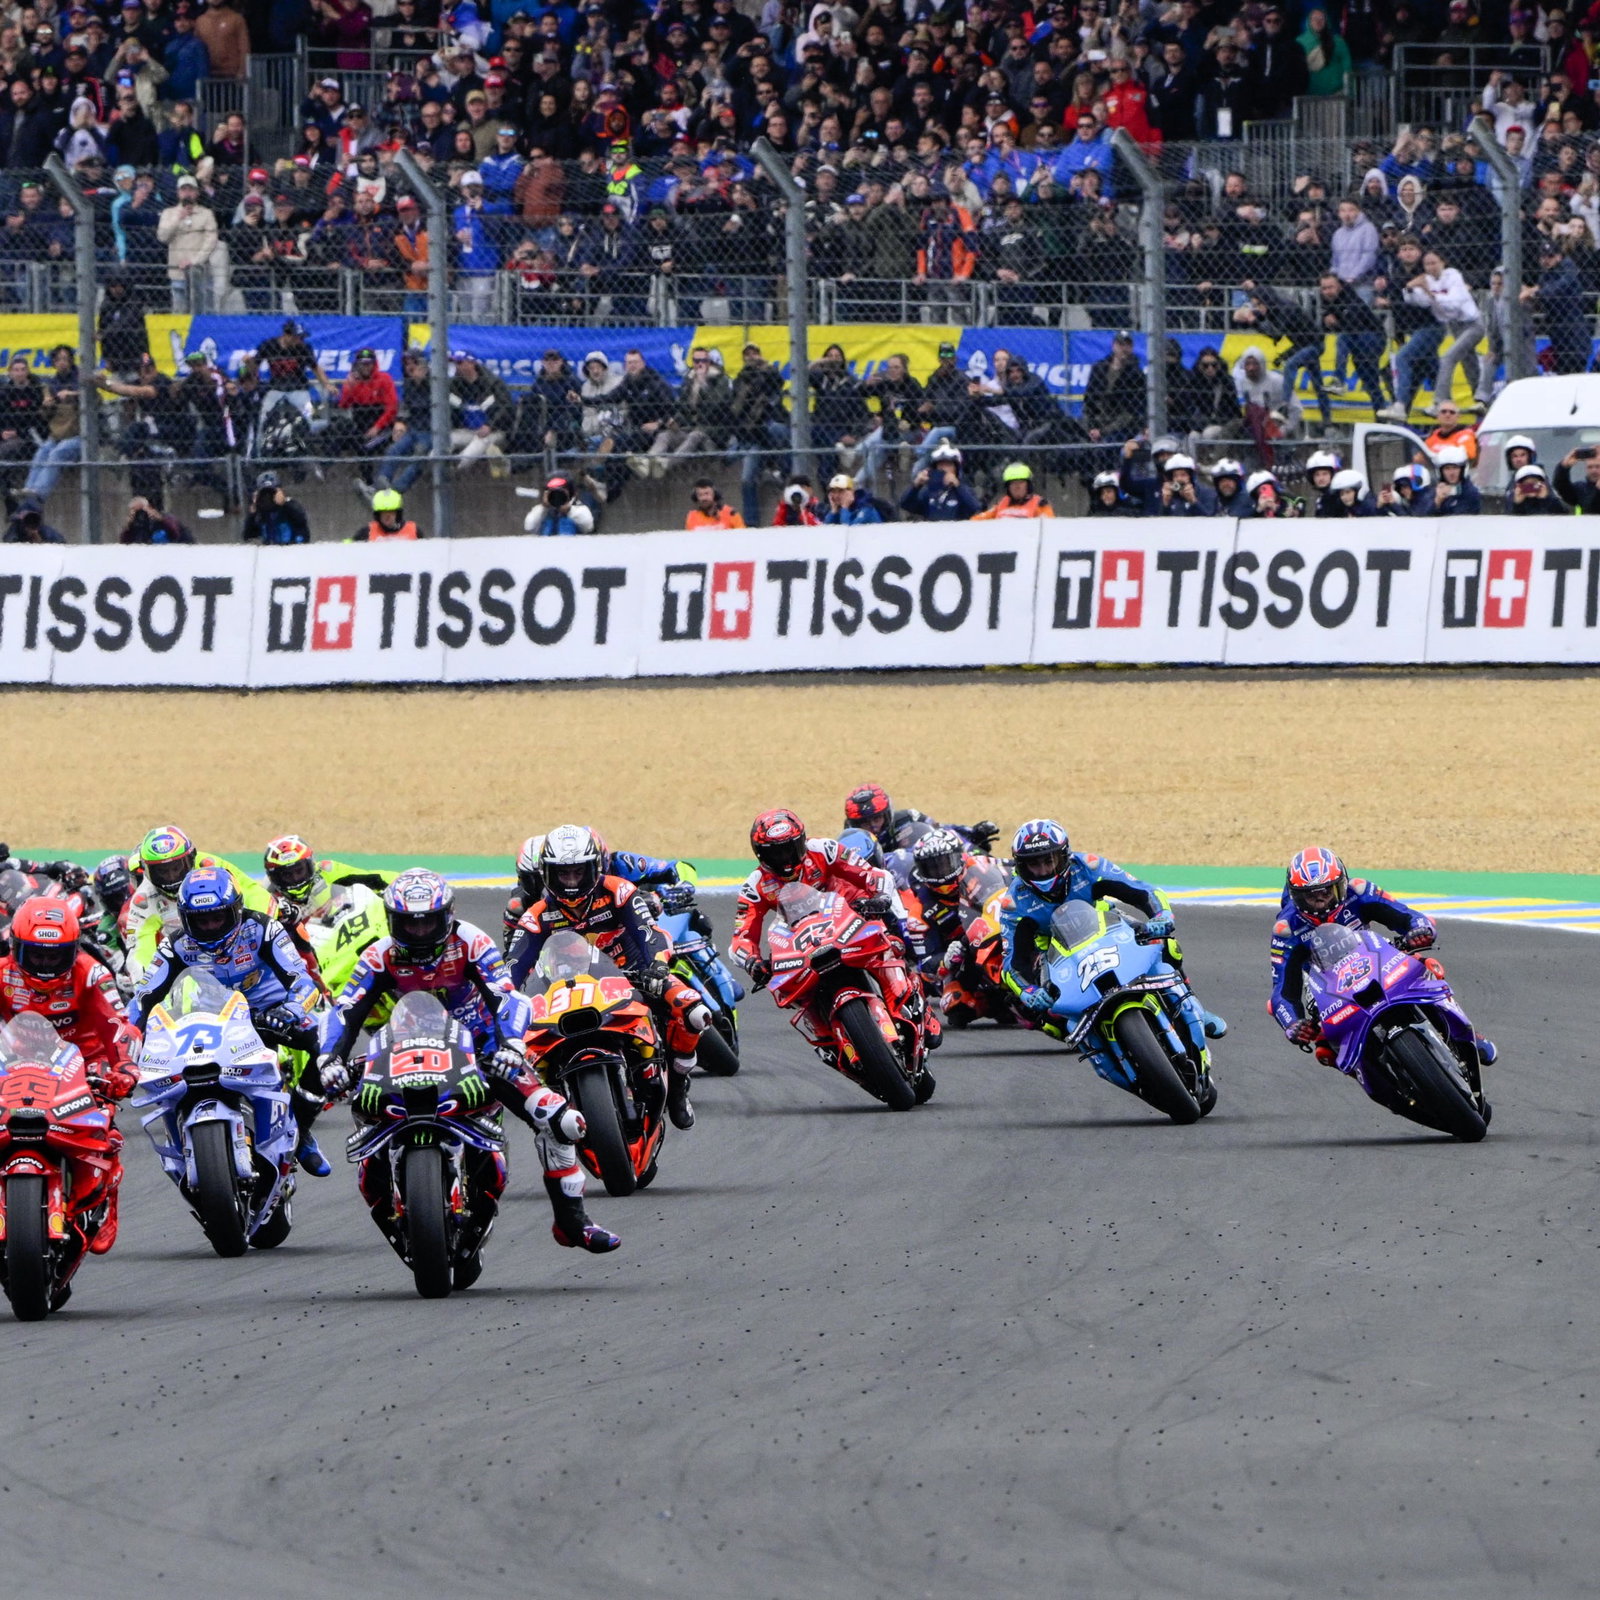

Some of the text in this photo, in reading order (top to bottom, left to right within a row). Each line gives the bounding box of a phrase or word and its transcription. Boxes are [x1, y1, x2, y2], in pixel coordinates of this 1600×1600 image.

[767, 551, 1017, 637] TISSOT
[1157, 549, 1410, 631] TISSOT
[370, 567, 626, 650] TISSOT
[1024, 841, 1050, 850] SHARK
[194, 896, 214, 905] SHOEI
[37, 930, 58, 938] SHOEI
[336, 911, 370, 952] 49
[837, 918, 862, 944] Lenovo
[1317, 932, 1356, 960] prim
[774, 959, 803, 970] Lenovo
[1077, 945, 1121, 993] 25
[1333, 951, 1361, 975] prima
[1381, 948, 1406, 974] prima
[1336, 956, 1373, 994] 43
[549, 982, 596, 1015] 37
[1319, 998, 1343, 1022] prima
[1331, 1006, 1354, 1024] MOTUL
[175, 1023, 223, 1057] 73
[230, 1038, 258, 1054] Unibat
[402, 1037, 446, 1049] ENEOS
[142, 1054, 170, 1066] Unibat
[389, 1047, 453, 1078] 20
[391, 1073, 449, 1086] MONSTER
[52, 1096, 92, 1118] Lenovo
[5, 1157, 44, 1171] Lenovo
